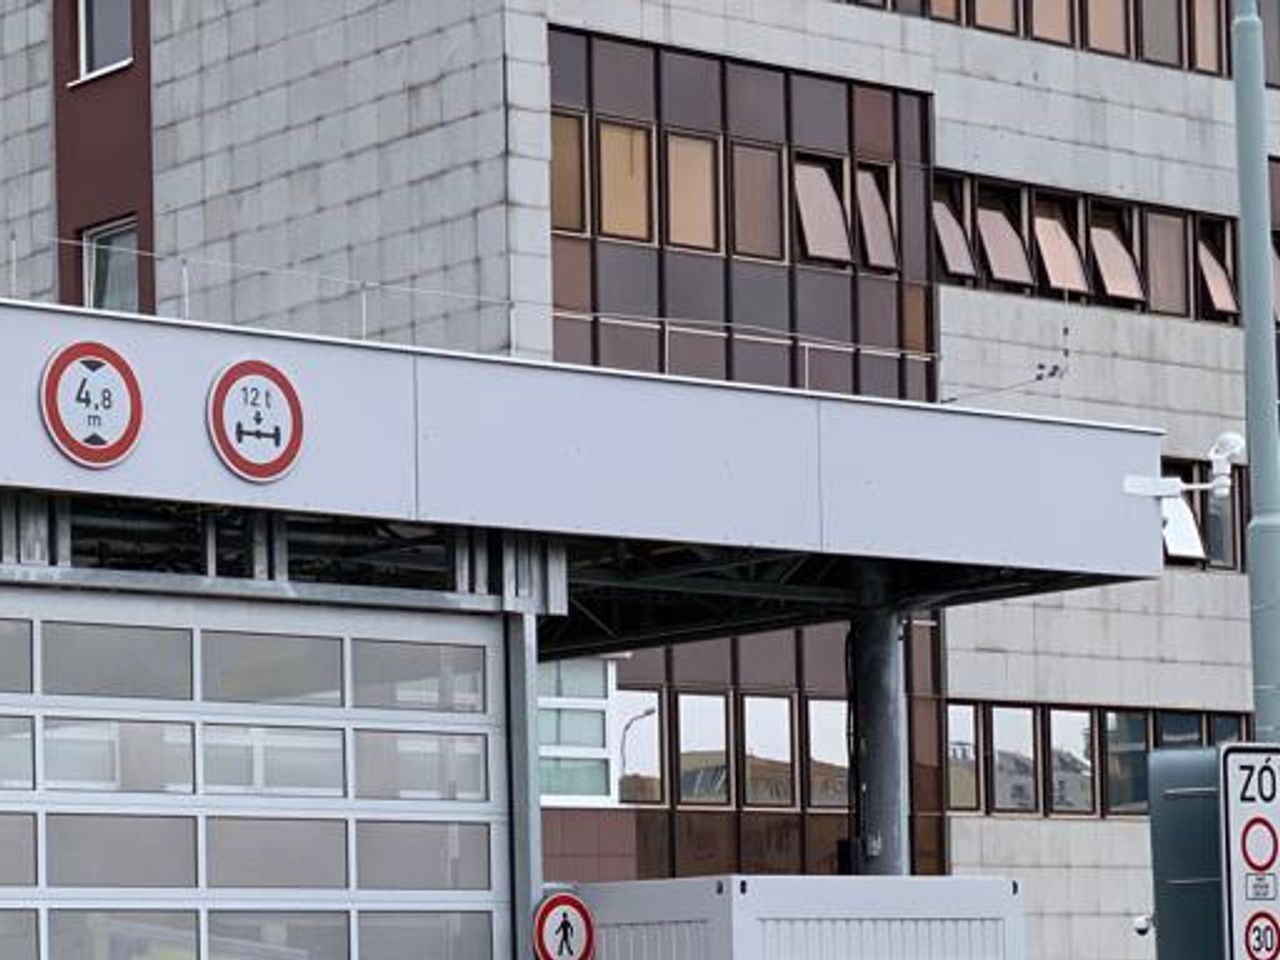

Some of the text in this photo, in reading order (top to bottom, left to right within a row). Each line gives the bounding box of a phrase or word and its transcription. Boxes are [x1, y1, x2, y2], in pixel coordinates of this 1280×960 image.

[241, 386, 272, 410] 12 t
[87, 415, 102, 427] m
[1252, 926, 1274, 951] 30
